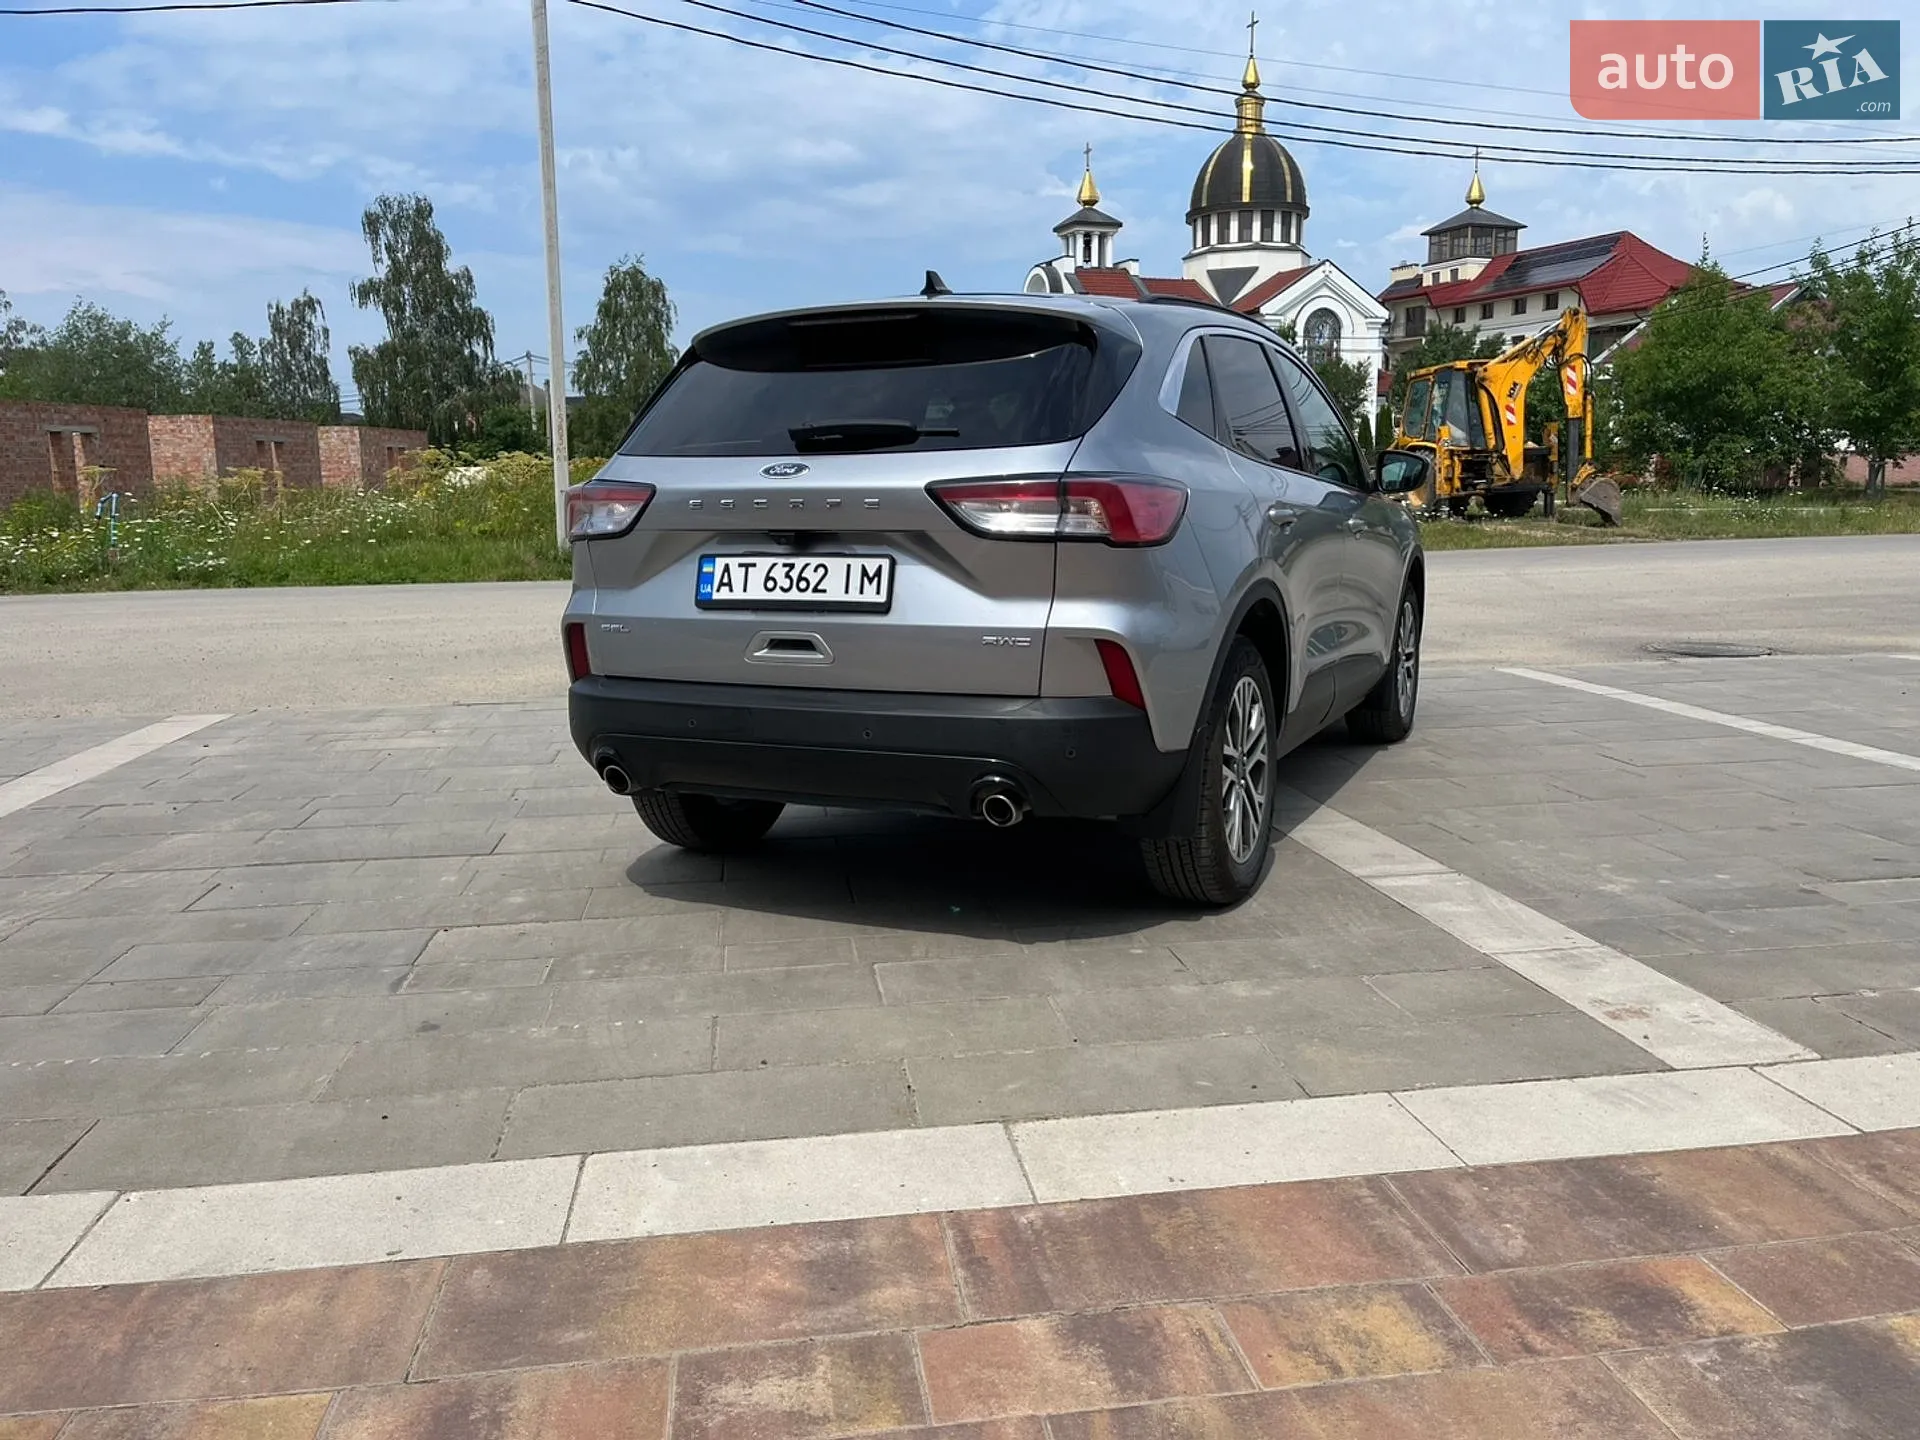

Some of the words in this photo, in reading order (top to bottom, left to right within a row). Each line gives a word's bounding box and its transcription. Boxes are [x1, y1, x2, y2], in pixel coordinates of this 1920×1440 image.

[700, 583, 712, 593] UA
[716, 562, 757, 593] AT
[763, 562, 829, 594] 6362
[844, 563, 883, 595] IM
